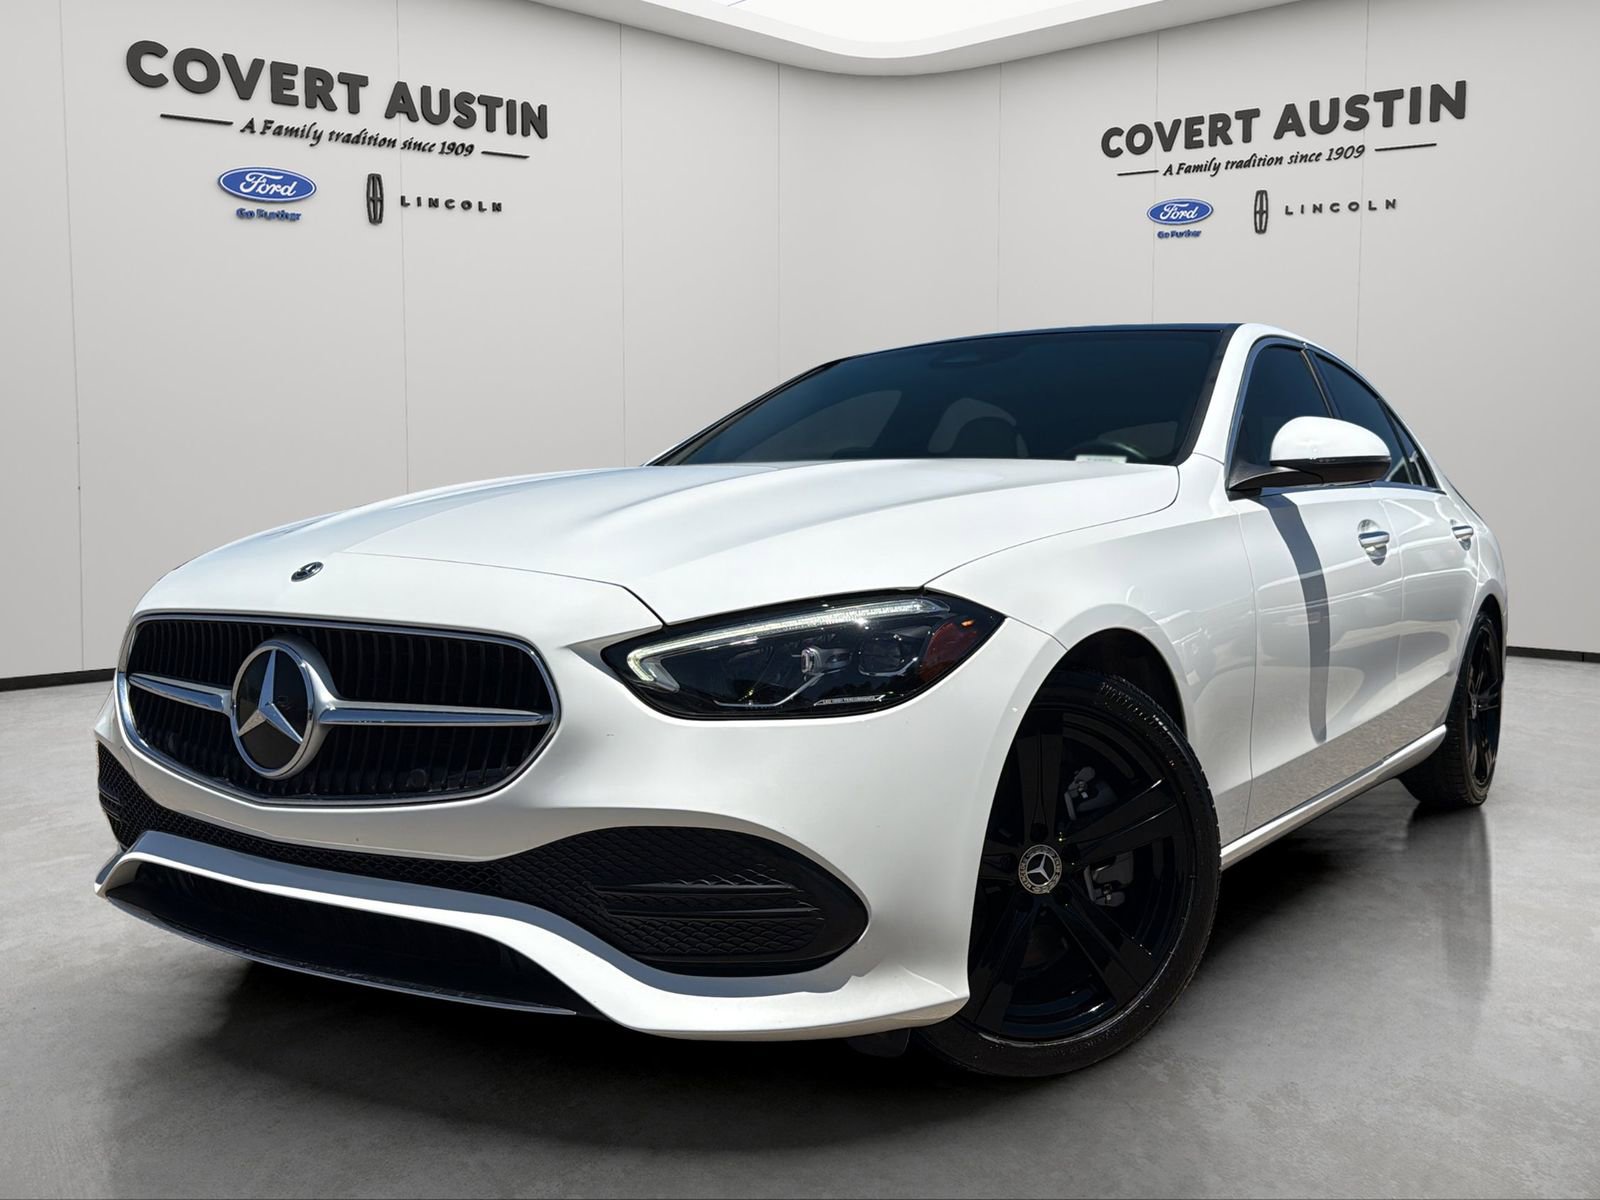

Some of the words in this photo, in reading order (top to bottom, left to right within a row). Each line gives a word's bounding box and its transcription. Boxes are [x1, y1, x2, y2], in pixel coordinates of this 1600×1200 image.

[125, 39, 370, 116] COVERT
[383, 80, 549, 140] AUSTIN
[1100, 107, 1261, 159] COVERT
[1272, 79, 1467, 141] AUSTIN
[240, 118, 257, 135] A
[259, 119, 323, 148] Family
[327, 129, 398, 150] tradition
[400, 136, 437, 153] since
[437, 140, 475, 158] 1909
[1162, 163, 1174, 177] A
[1175, 156, 1222, 178] Family
[1224, 152, 1284, 171] tradition
[1287, 151, 1323, 166] since
[1325, 144, 1366, 162] 1909
[239, 172, 298, 197] Ford
[400, 195, 502, 213] LINCOLN
[1159, 203, 1199, 220] Ford
[1284, 198, 1397, 216] LINCOLN
